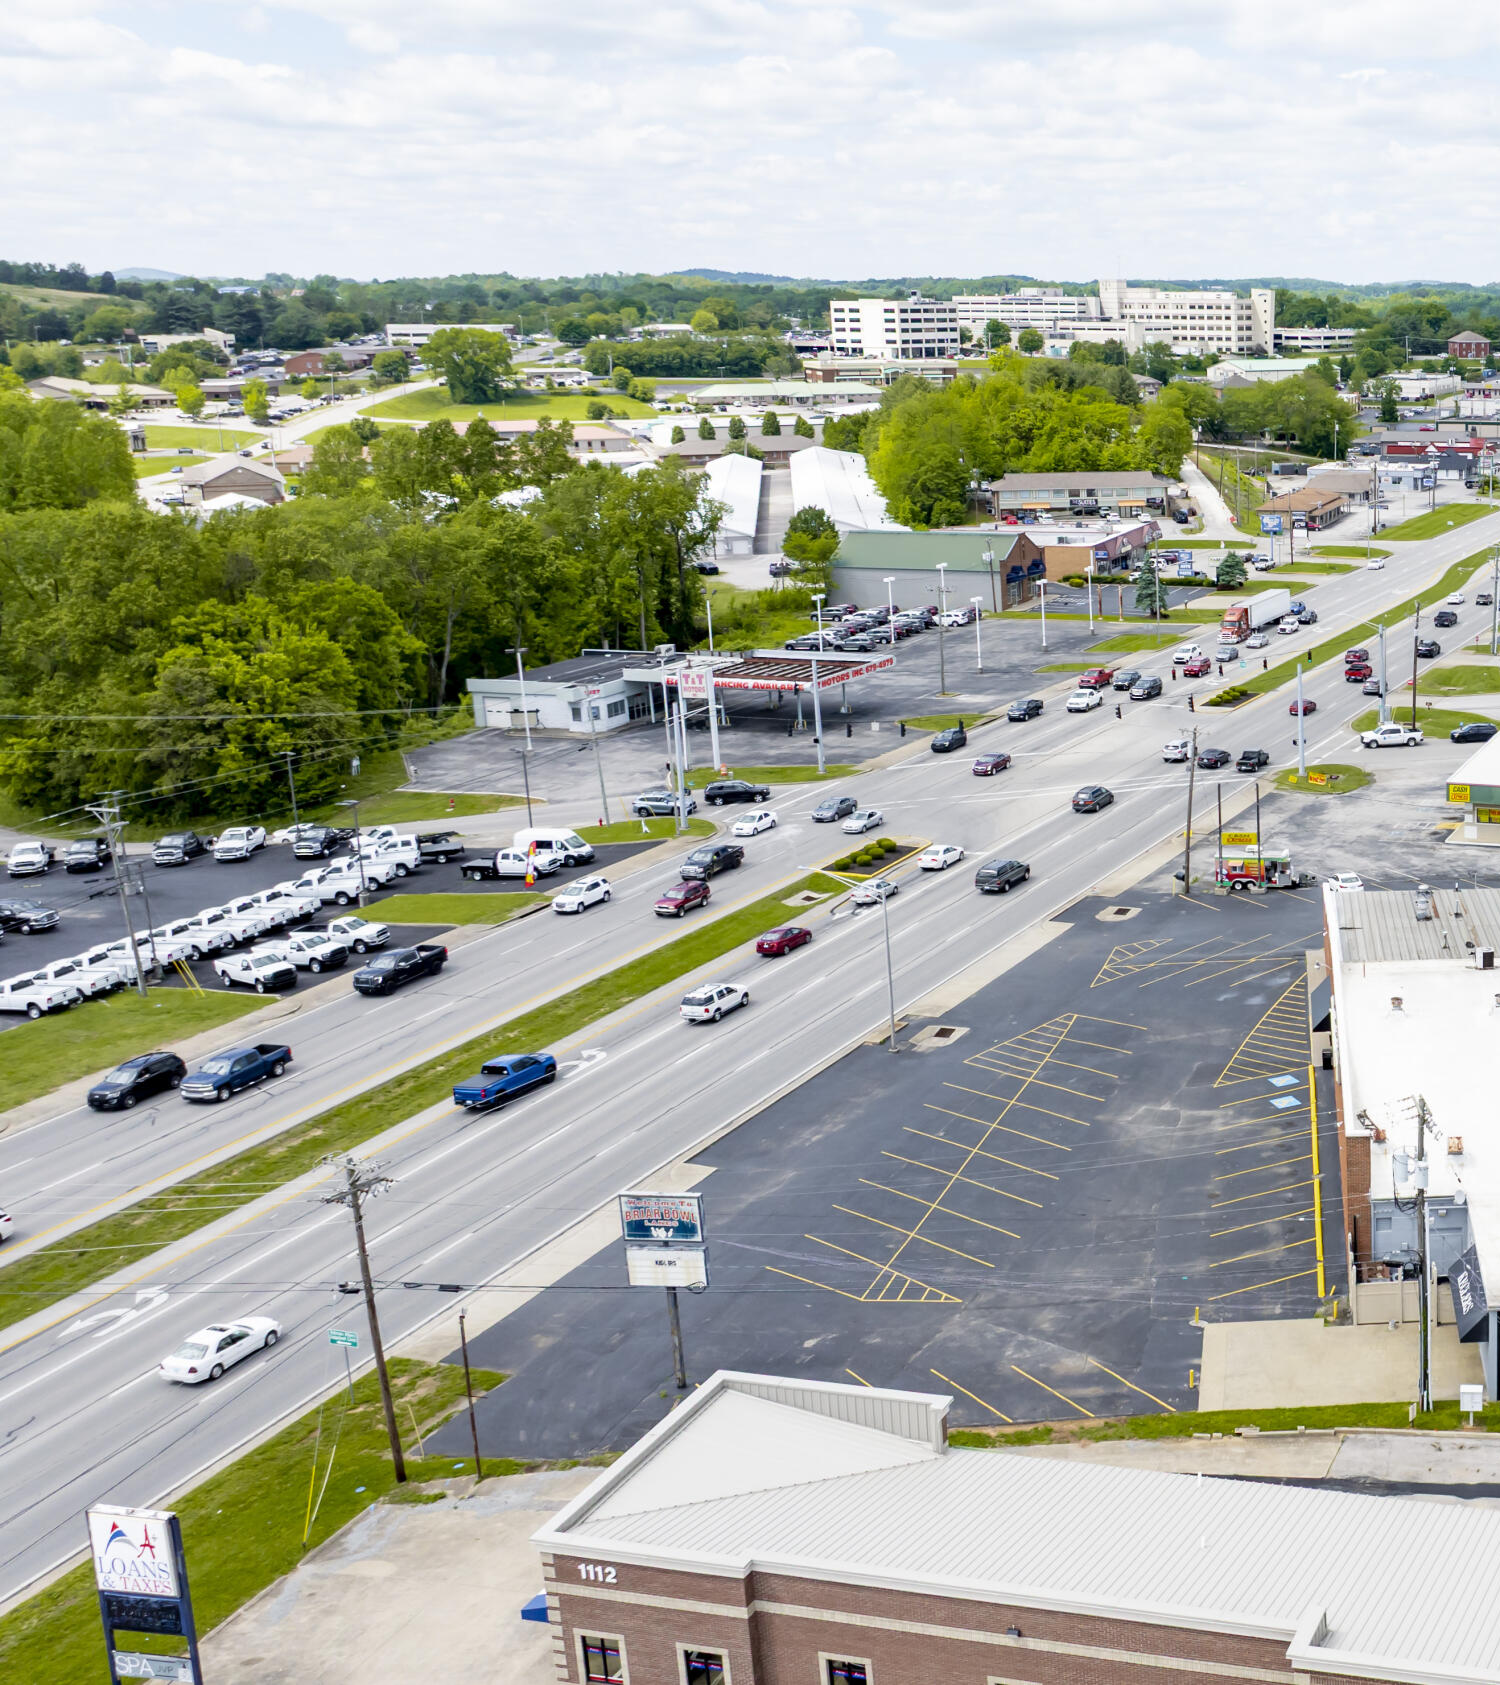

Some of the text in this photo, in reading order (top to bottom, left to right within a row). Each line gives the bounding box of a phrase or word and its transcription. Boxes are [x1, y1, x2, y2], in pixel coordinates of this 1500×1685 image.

[625, 1208, 697, 1223] BRIAR BOWL
[644, 1219, 679, 1227] LANES
[98, 1556, 170, 1580] LOANS
[577, 1563, 618, 1584] 1112
[102, 1575, 172, 1593] & TAXES
[115, 1655, 155, 1676] SPA
